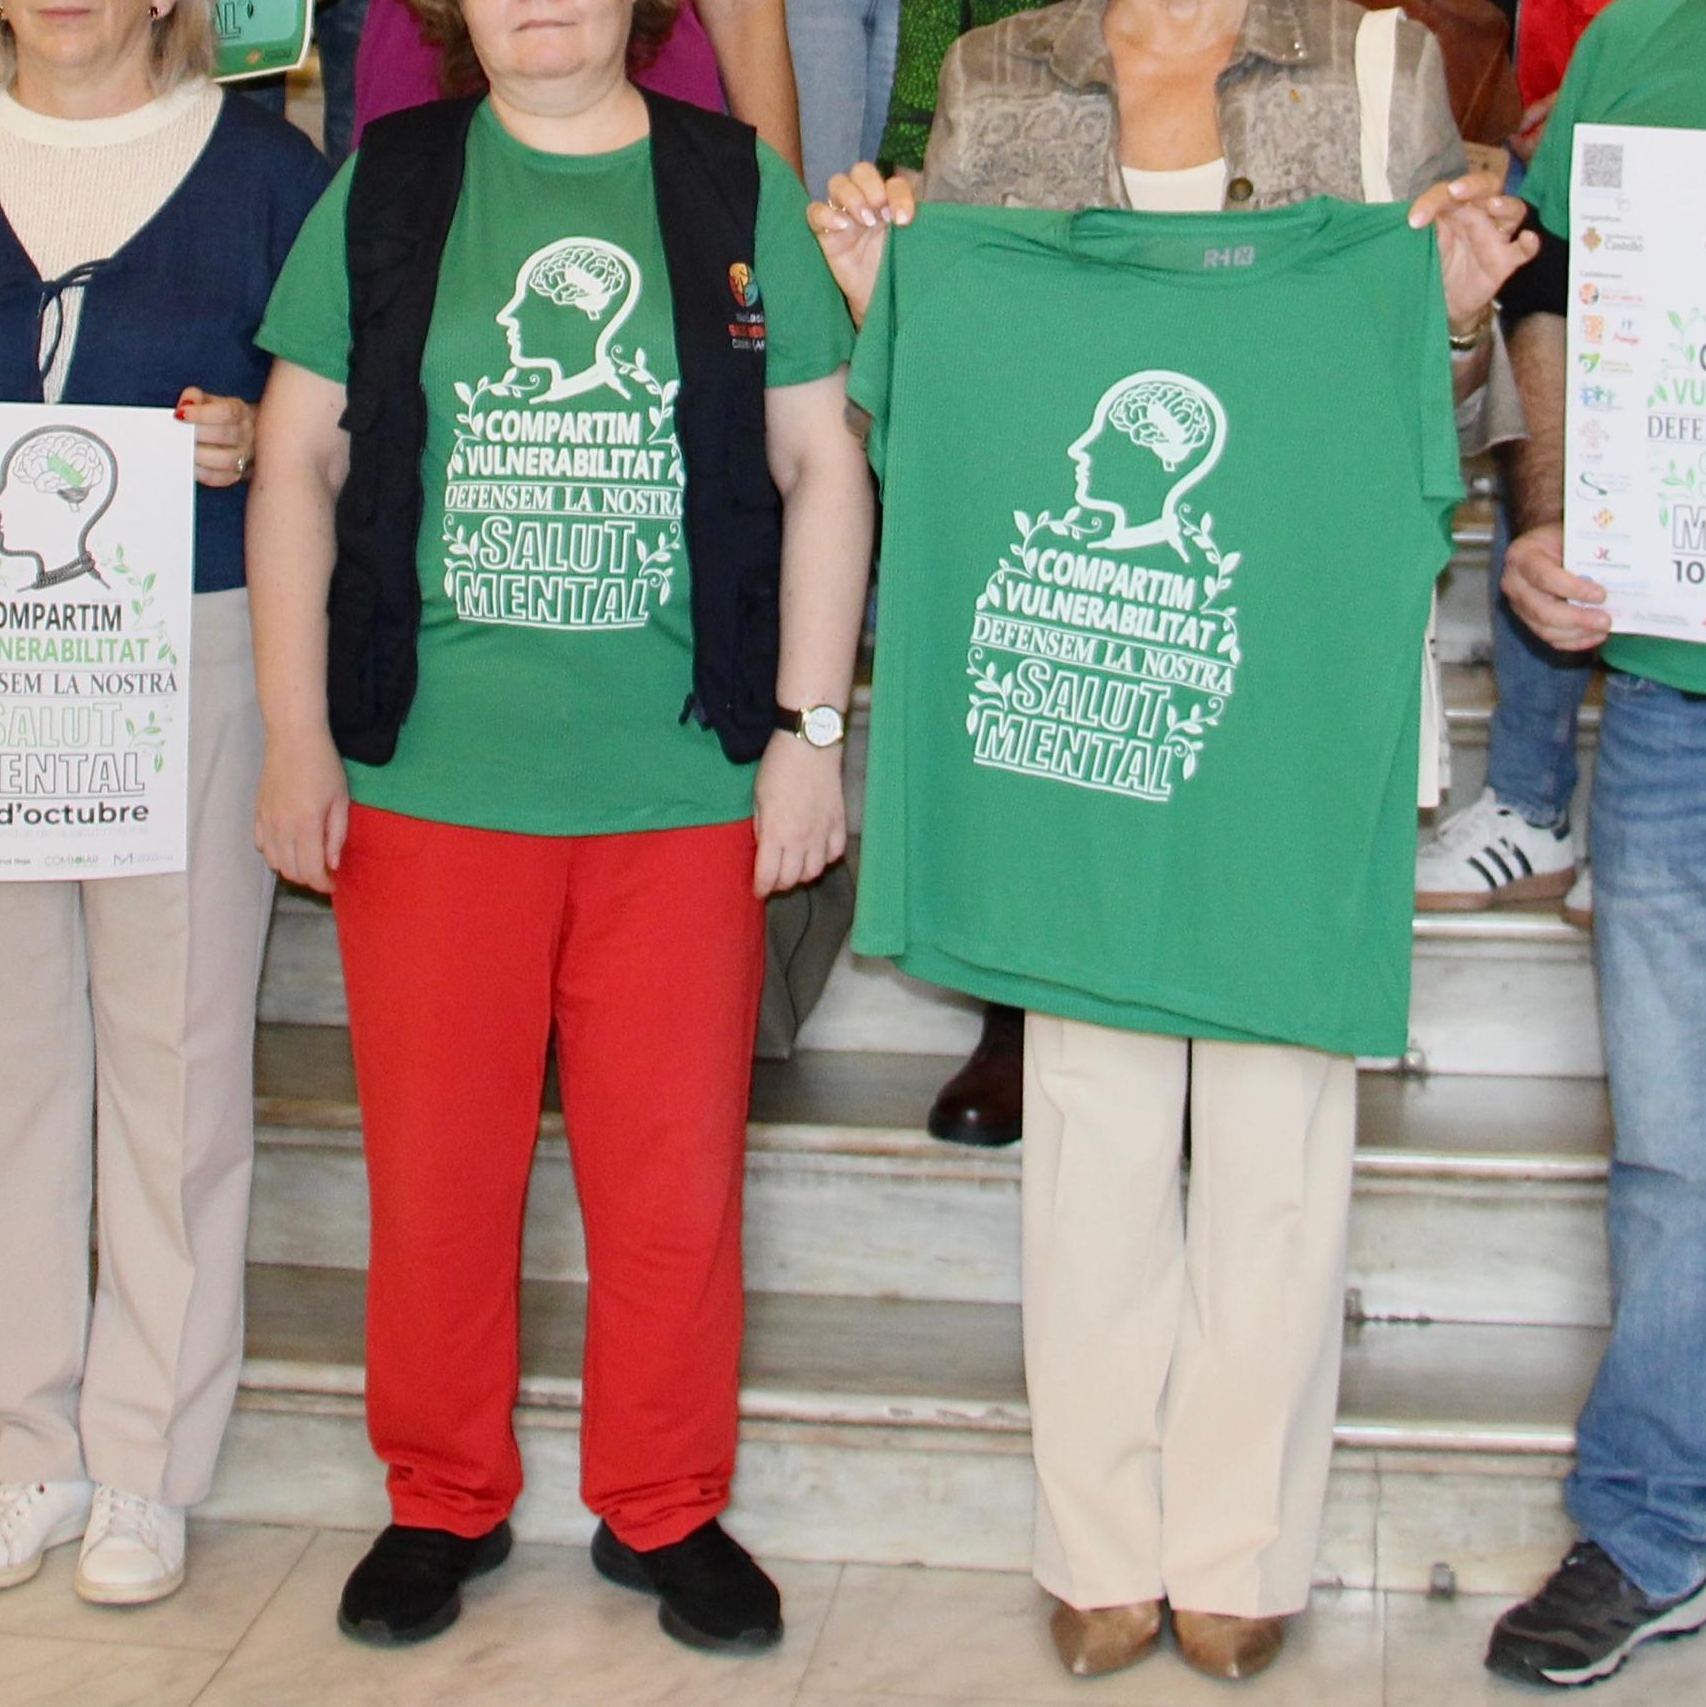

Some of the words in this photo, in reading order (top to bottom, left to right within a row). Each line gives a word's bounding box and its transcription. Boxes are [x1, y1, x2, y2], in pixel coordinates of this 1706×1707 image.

[484, 409, 641, 445] COMPARTIM
[465, 445, 666, 481] VULNERABILITAT
[444, 484, 553, 511] DEFENSEM
[564, 487, 592, 512] LA
[601, 488, 683, 516] NOSTRA
[479, 515, 637, 575] SALUT
[1672, 559, 1706, 584] 10
[455, 570, 649, 624] MENTAL
[1037, 548, 1195, 610] COMPARTIM
[1006, 580, 1217, 651] VULNERABILITAT
[53, 673, 80, 695] LA
[90, 671, 178, 695] NOSTRA
[973, 615, 1098, 664] DEFENSEM
[1103, 641, 1133, 673] LA
[1142, 648, 1234, 695] NOSTRA
[1011, 658, 1171, 739] SALUT
[973, 710, 1174, 795] MENTAL
